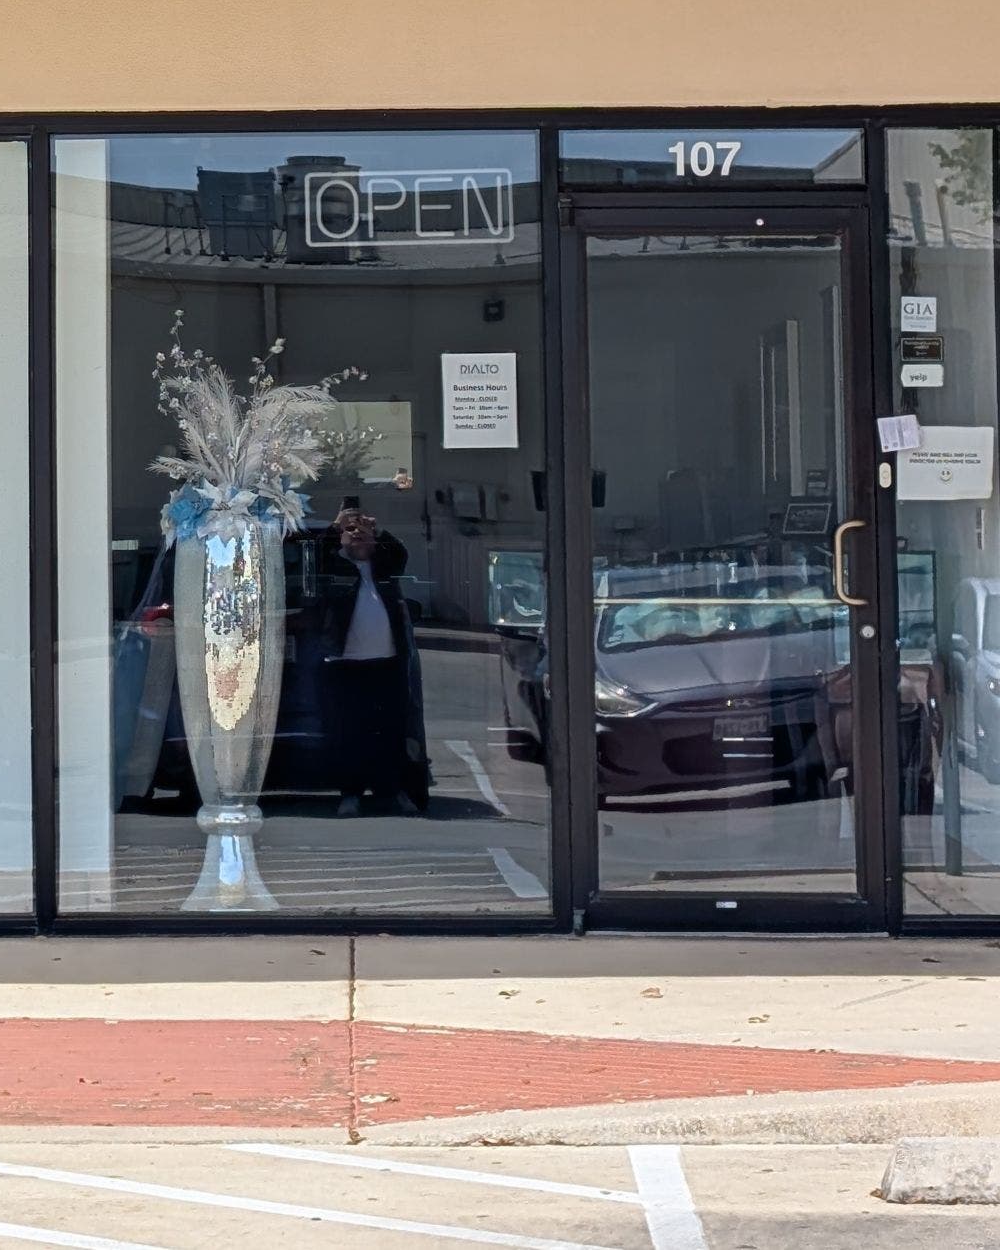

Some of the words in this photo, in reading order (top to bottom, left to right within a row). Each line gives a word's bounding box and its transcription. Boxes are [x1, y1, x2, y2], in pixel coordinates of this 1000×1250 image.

[667, 140, 742, 178] 107
[315, 174, 503, 240] OPEN
[903, 302, 933, 316] GIA
[460, 363, 500, 375] RIALTO
[909, 373, 928, 382] yelp
[453, 384, 485, 392] Business
[486, 384, 508, 392] Hours
